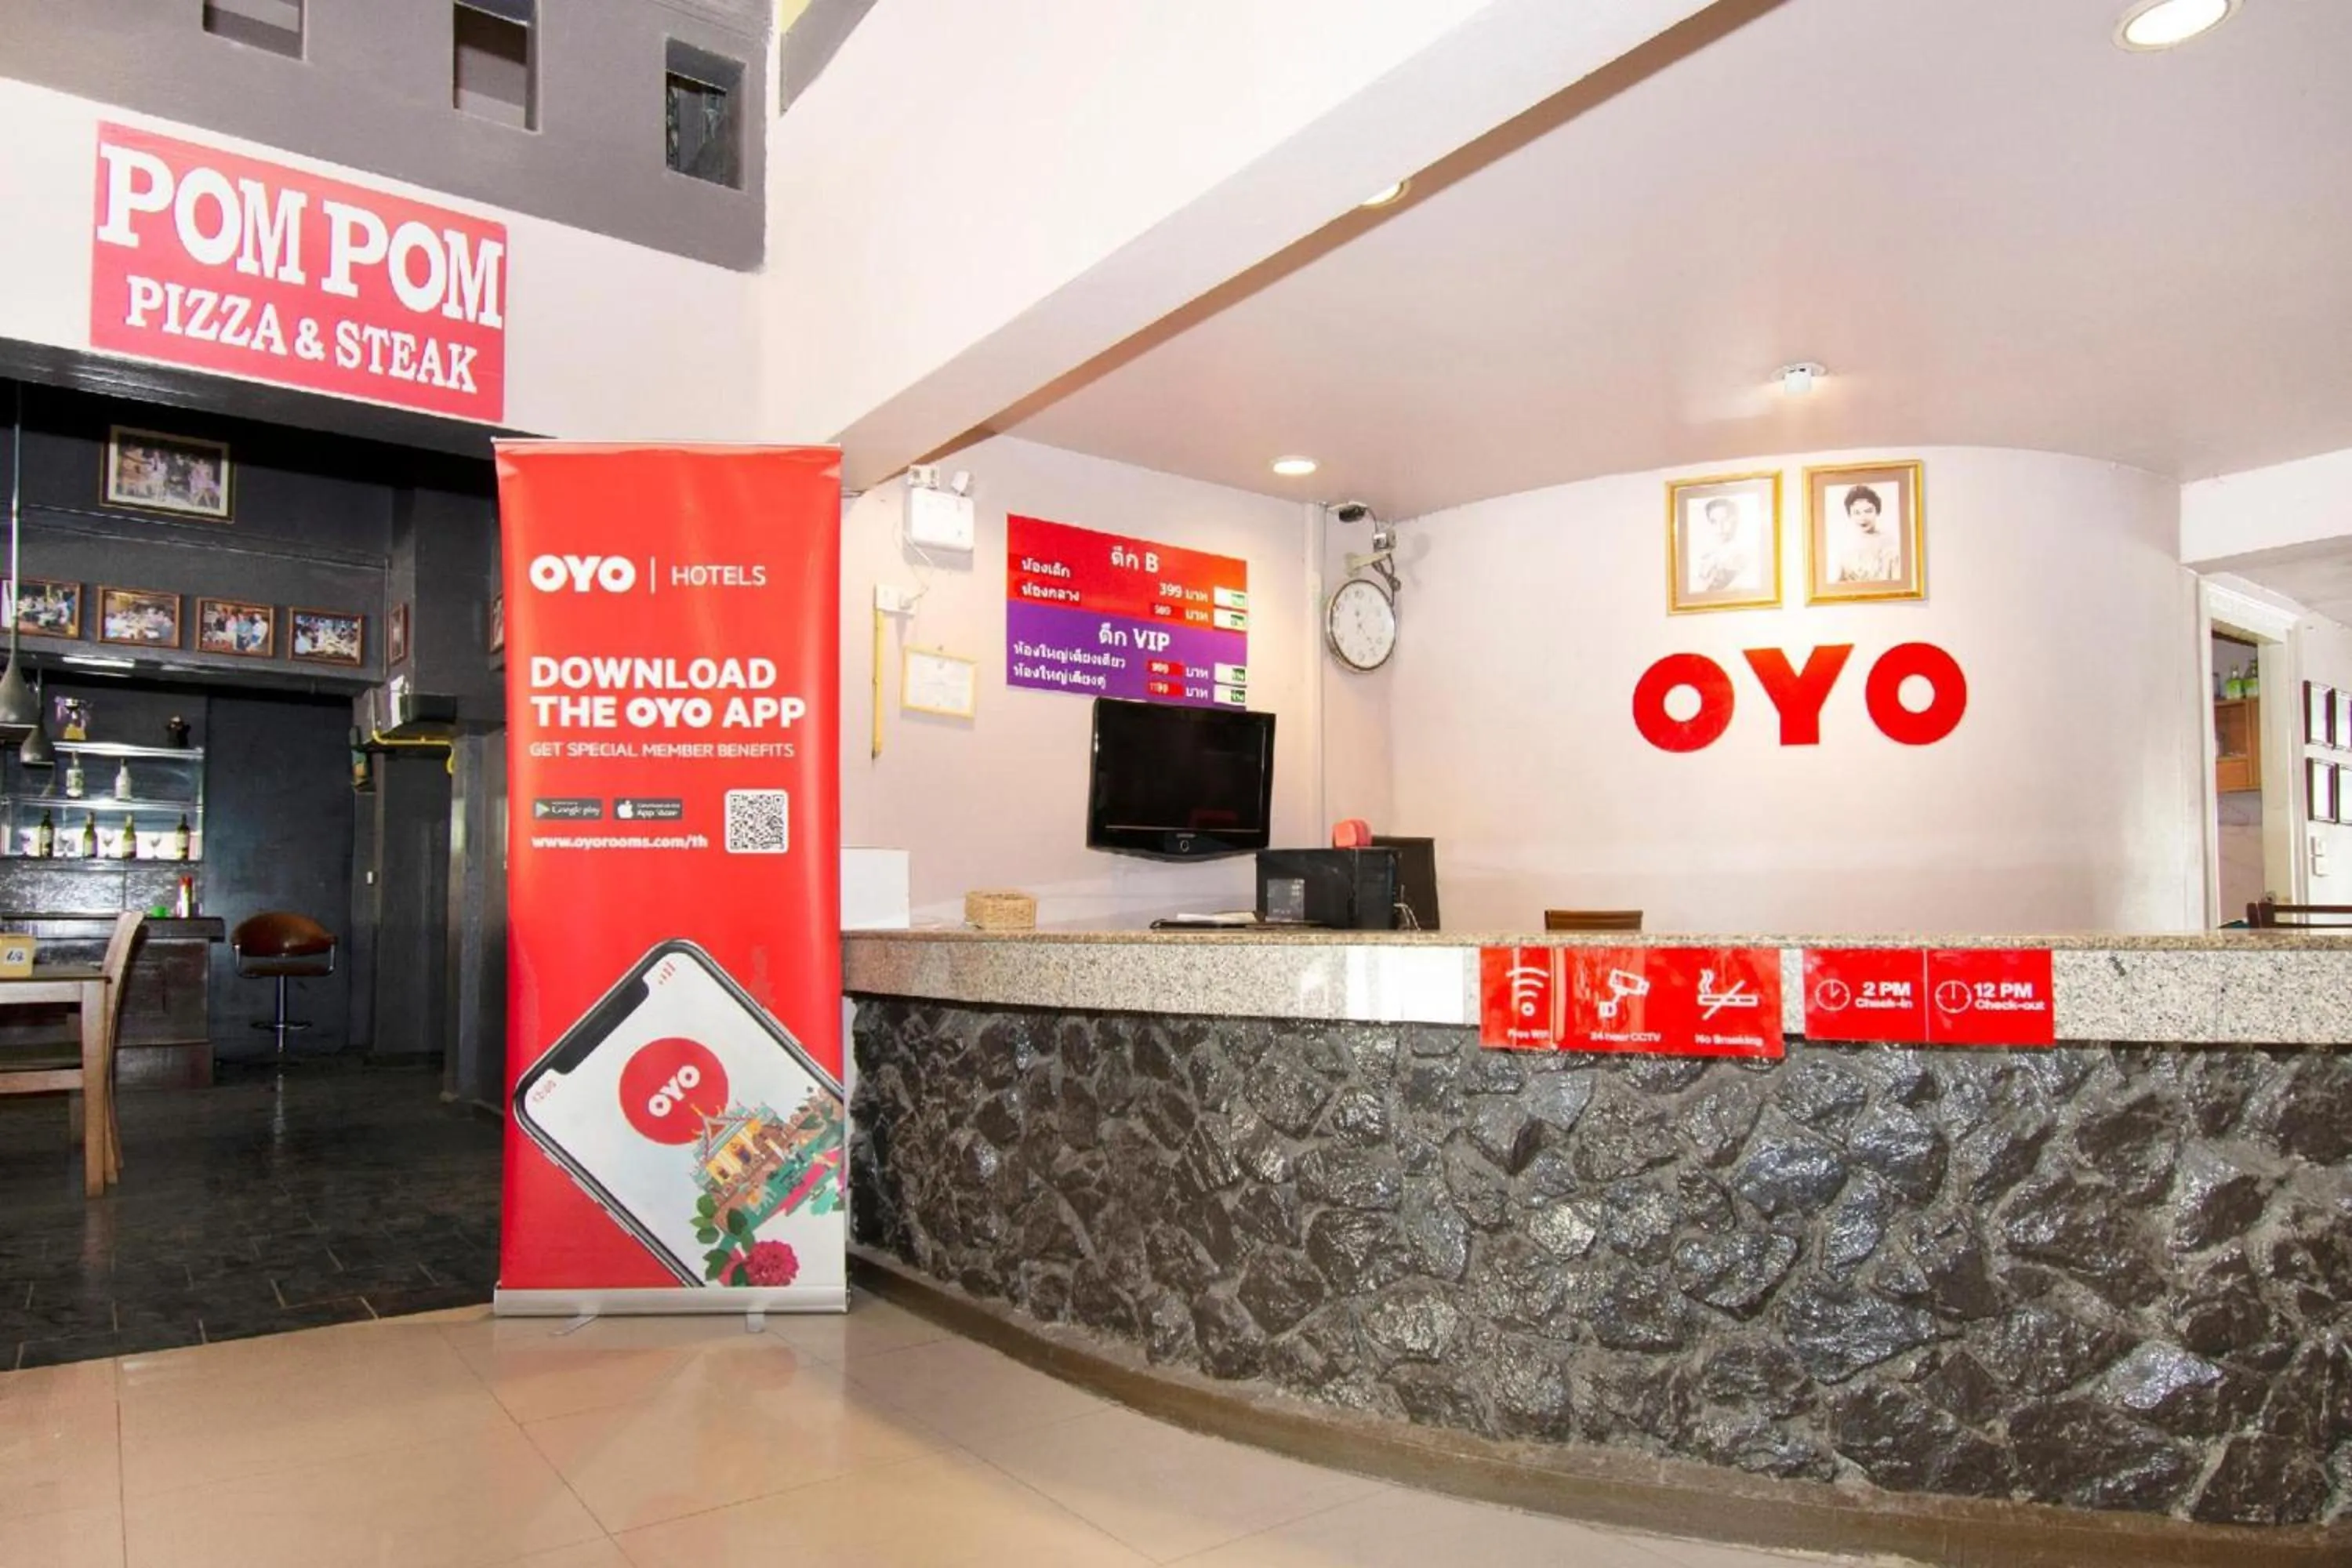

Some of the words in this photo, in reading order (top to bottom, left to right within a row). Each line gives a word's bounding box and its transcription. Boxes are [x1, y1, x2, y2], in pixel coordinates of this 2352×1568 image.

[97, 142, 307, 285] POM
[321, 201, 503, 329] POM
[125, 275, 288, 356] PIZZA
[294, 318, 325, 361] &
[336, 320, 477, 394] STEAK
[1145, 552, 1159, 572] B
[529, 554, 636, 593] OYO
[671, 565, 766, 586] HOTELS
[1159, 583, 1182, 598] 399
[1185, 590, 1208, 603] บาท
[1185, 609, 1208, 621] บาท
[1133, 629, 1170, 652] VIP
[530, 656, 777, 689] DOWNLOAD
[1186, 667, 1208, 680] บาท
[1186, 687, 1208, 699] บาท
[1632, 642, 1967, 753] OYO
[530, 695, 617, 728] THE
[626, 697, 713, 728] OYO
[722, 697, 806, 728] APP
[530, 742, 563, 757] GET
[566, 742, 637, 757] SPECIAL
[642, 743, 713, 757] MEMBER
[717, 743, 794, 757] BENEFITS
[532, 835, 708, 849] www.oyorooms.com/th
[1863, 982, 1875, 996] 2
[1879, 982, 1911, 996] PM
[1974, 983, 1995, 998] 12
[2001, 983, 2032, 998] PM
[1974, 999, 2045, 1011] Check-out
[648, 1065, 700, 1117] OYO
